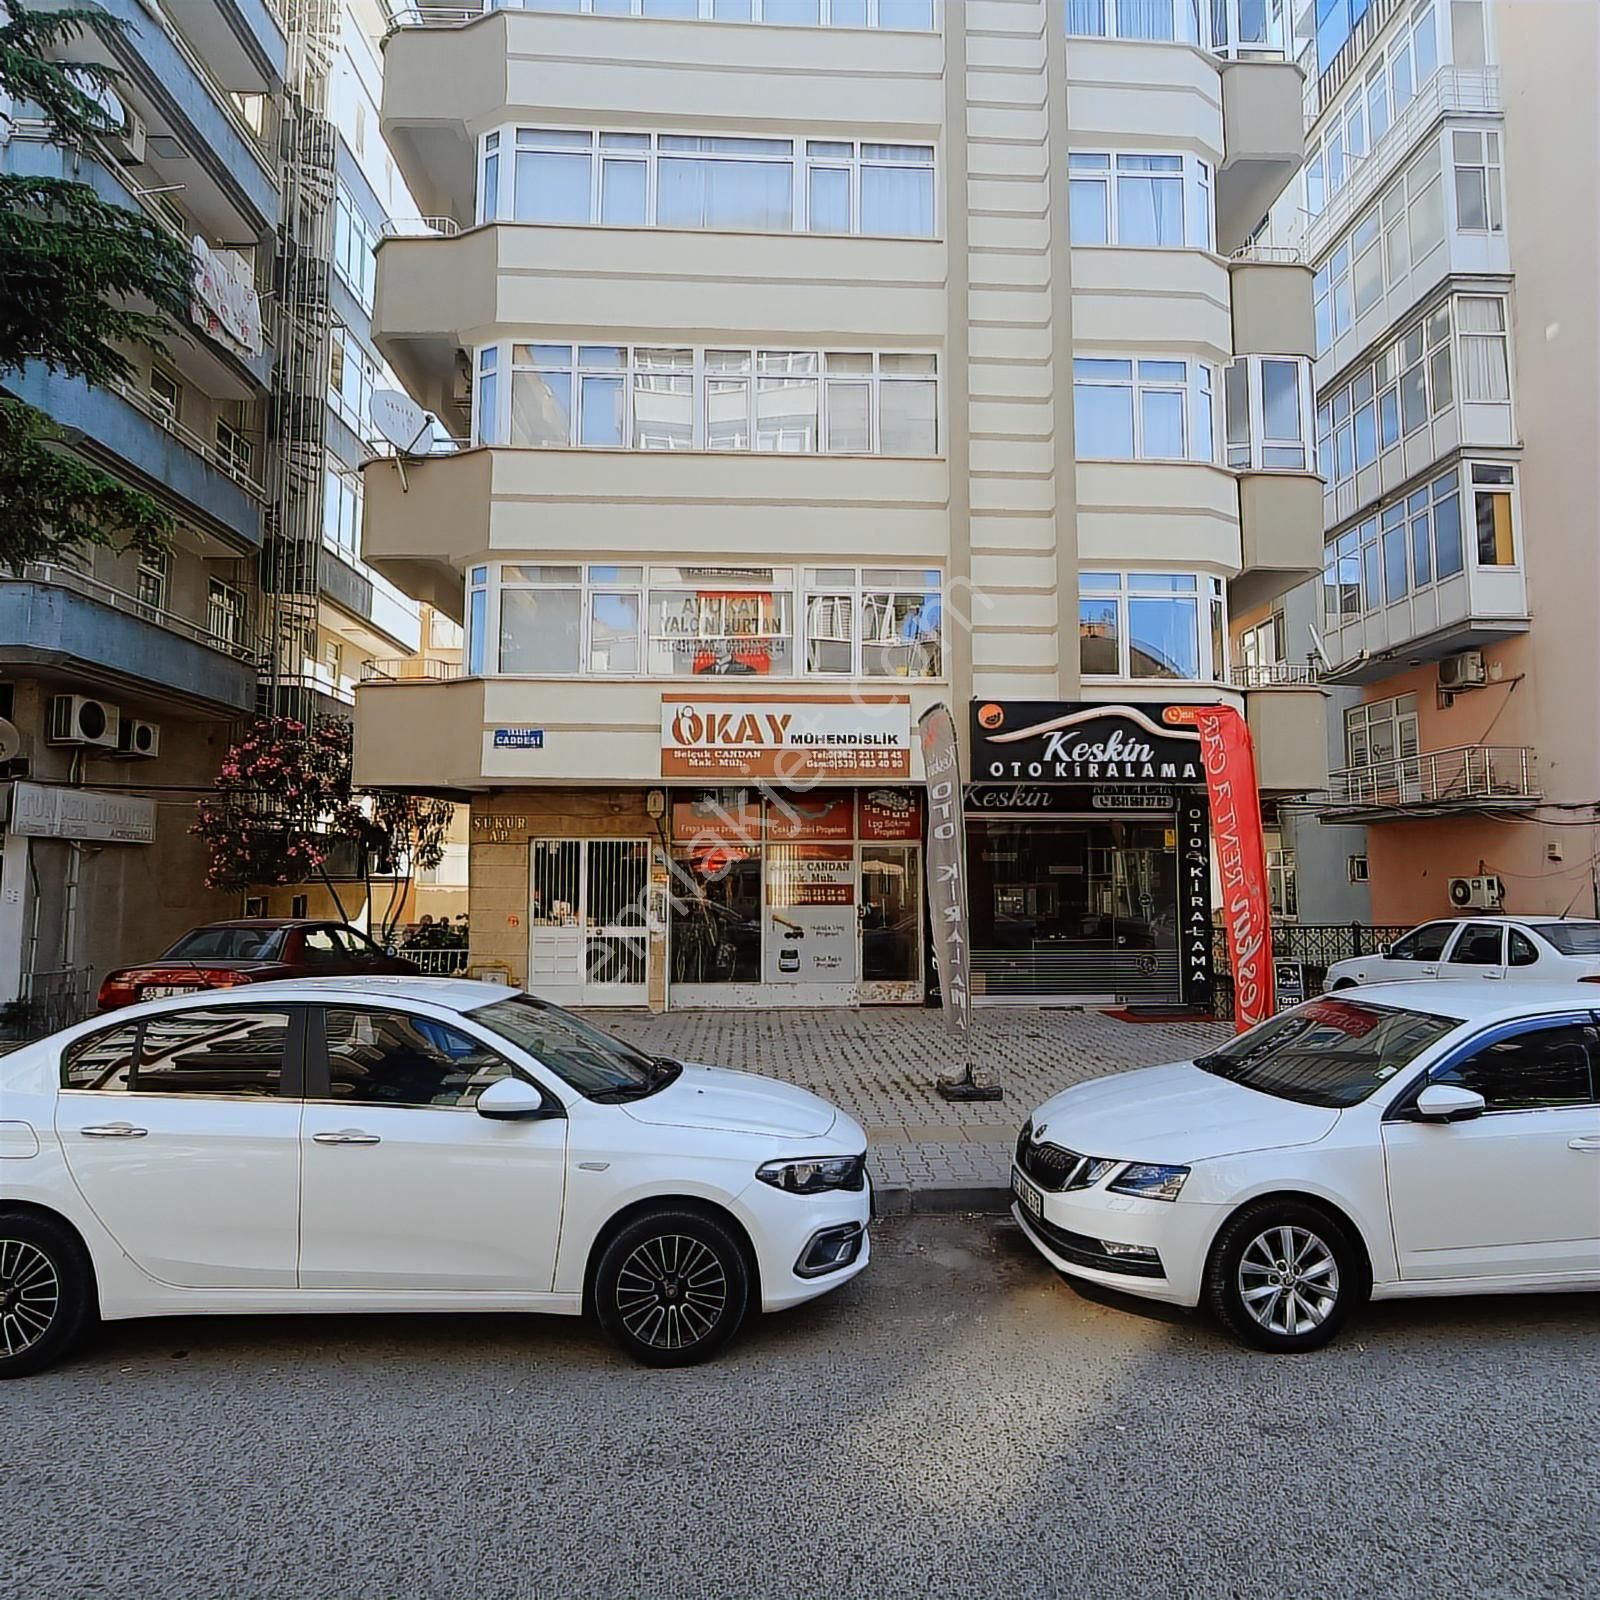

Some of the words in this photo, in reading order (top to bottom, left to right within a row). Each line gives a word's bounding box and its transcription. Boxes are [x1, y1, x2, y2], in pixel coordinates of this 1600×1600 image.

[790, 731, 899, 745] MÜHENDİSLİK
[1041, 729, 1154, 763] Keskin
[714, 750, 761, 758] CANDAN
[989, 762, 1042, 777] OTO
[964, 784, 1054, 808] Keskin
[1188, 808, 1201, 848] OTO
[806, 862, 851, 871] CANDAN
